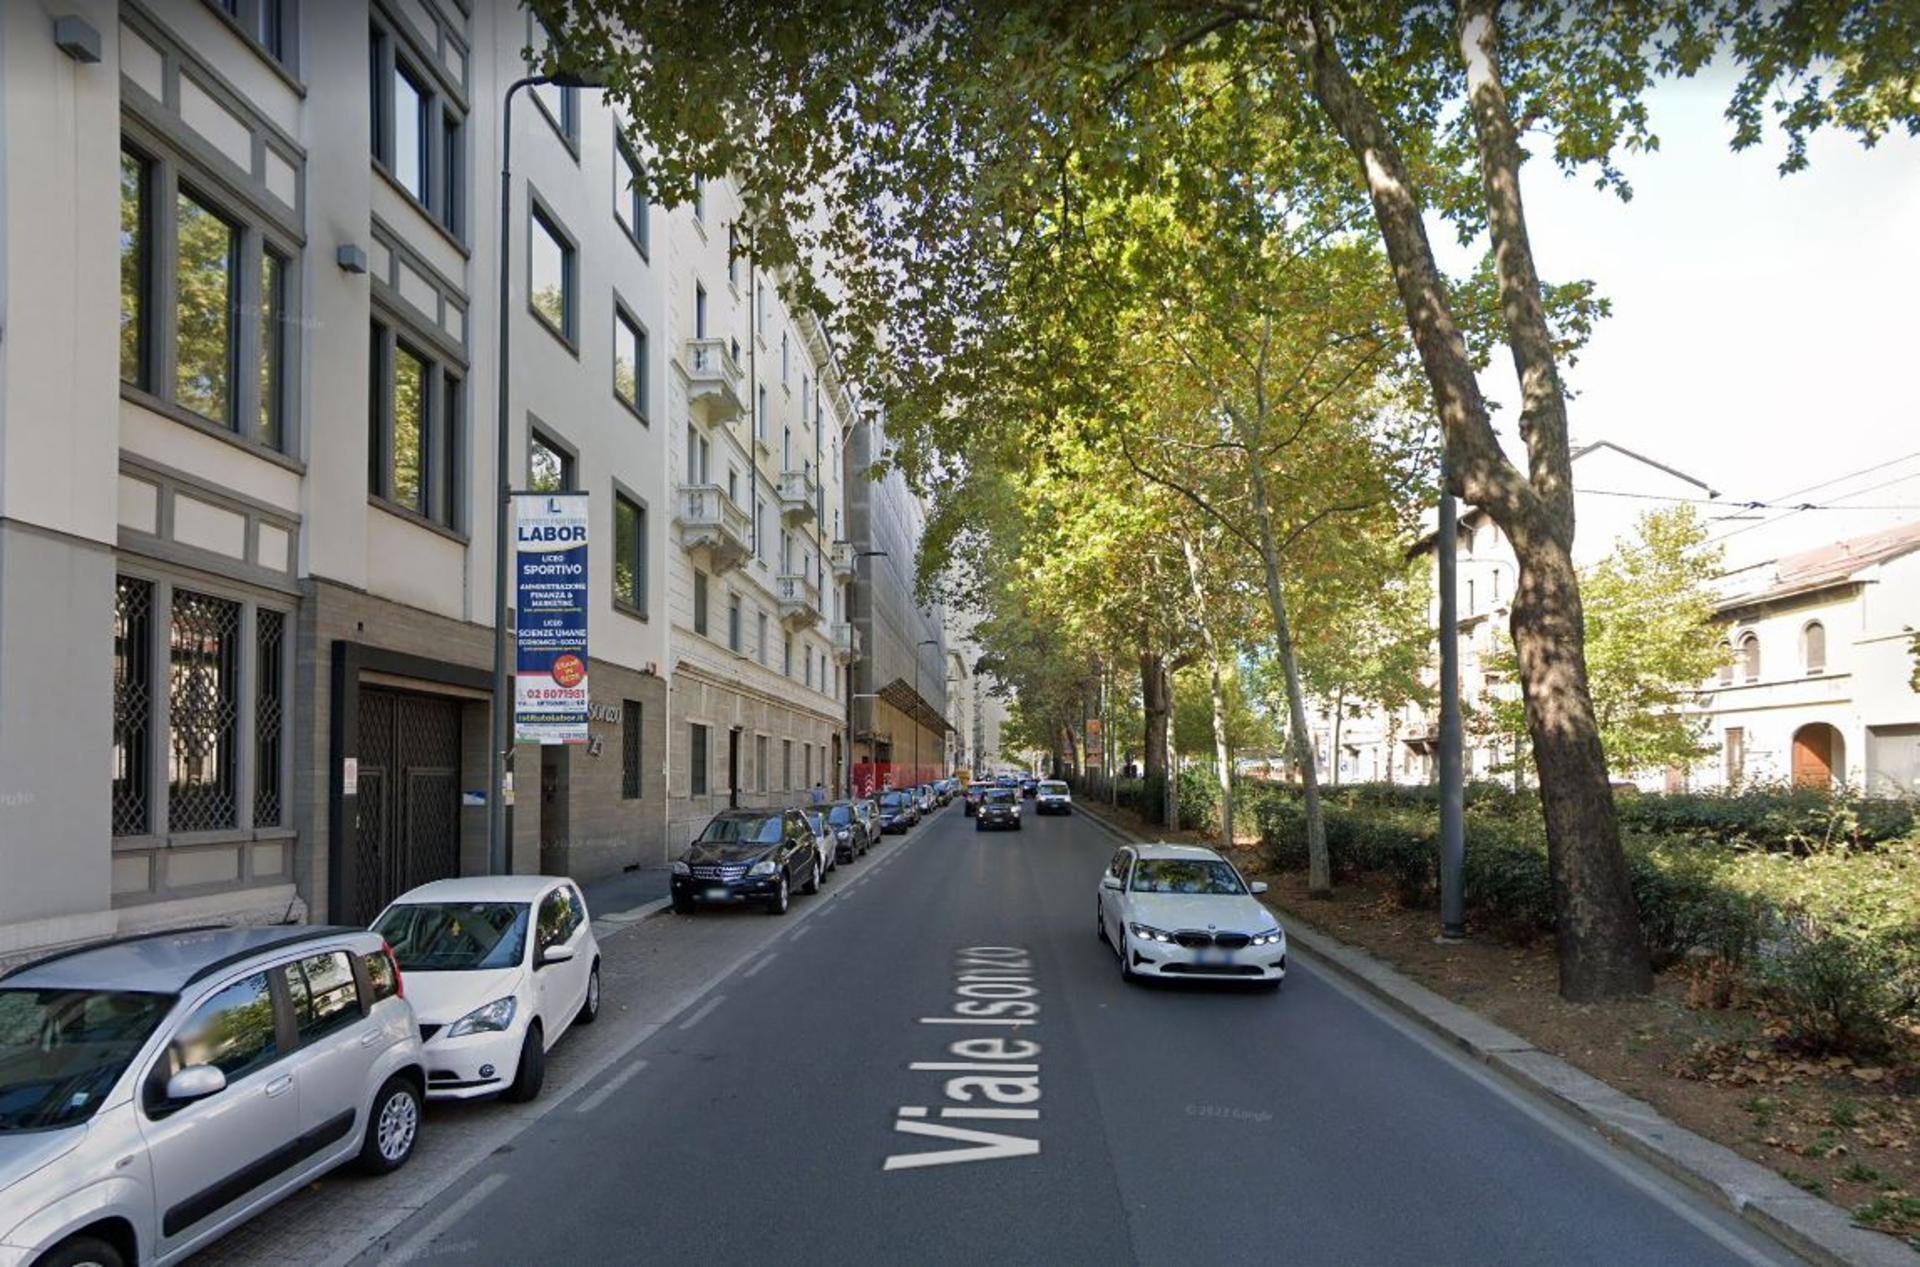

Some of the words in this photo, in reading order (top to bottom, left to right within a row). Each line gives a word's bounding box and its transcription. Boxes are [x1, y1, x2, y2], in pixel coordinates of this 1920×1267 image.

[518, 526, 586, 541] LABOR
[541, 555, 564, 563] LICEO
[523, 564, 582, 575] SPORTIVO
[530, 591, 566, 599] FINANZA
[532, 599, 574, 607] MARKETING
[543, 619, 563, 627] LICEO
[519, 629, 554, 637] SCIENZE
[555, 629, 586, 637] UMANE
[527, 689, 541, 699] 02
